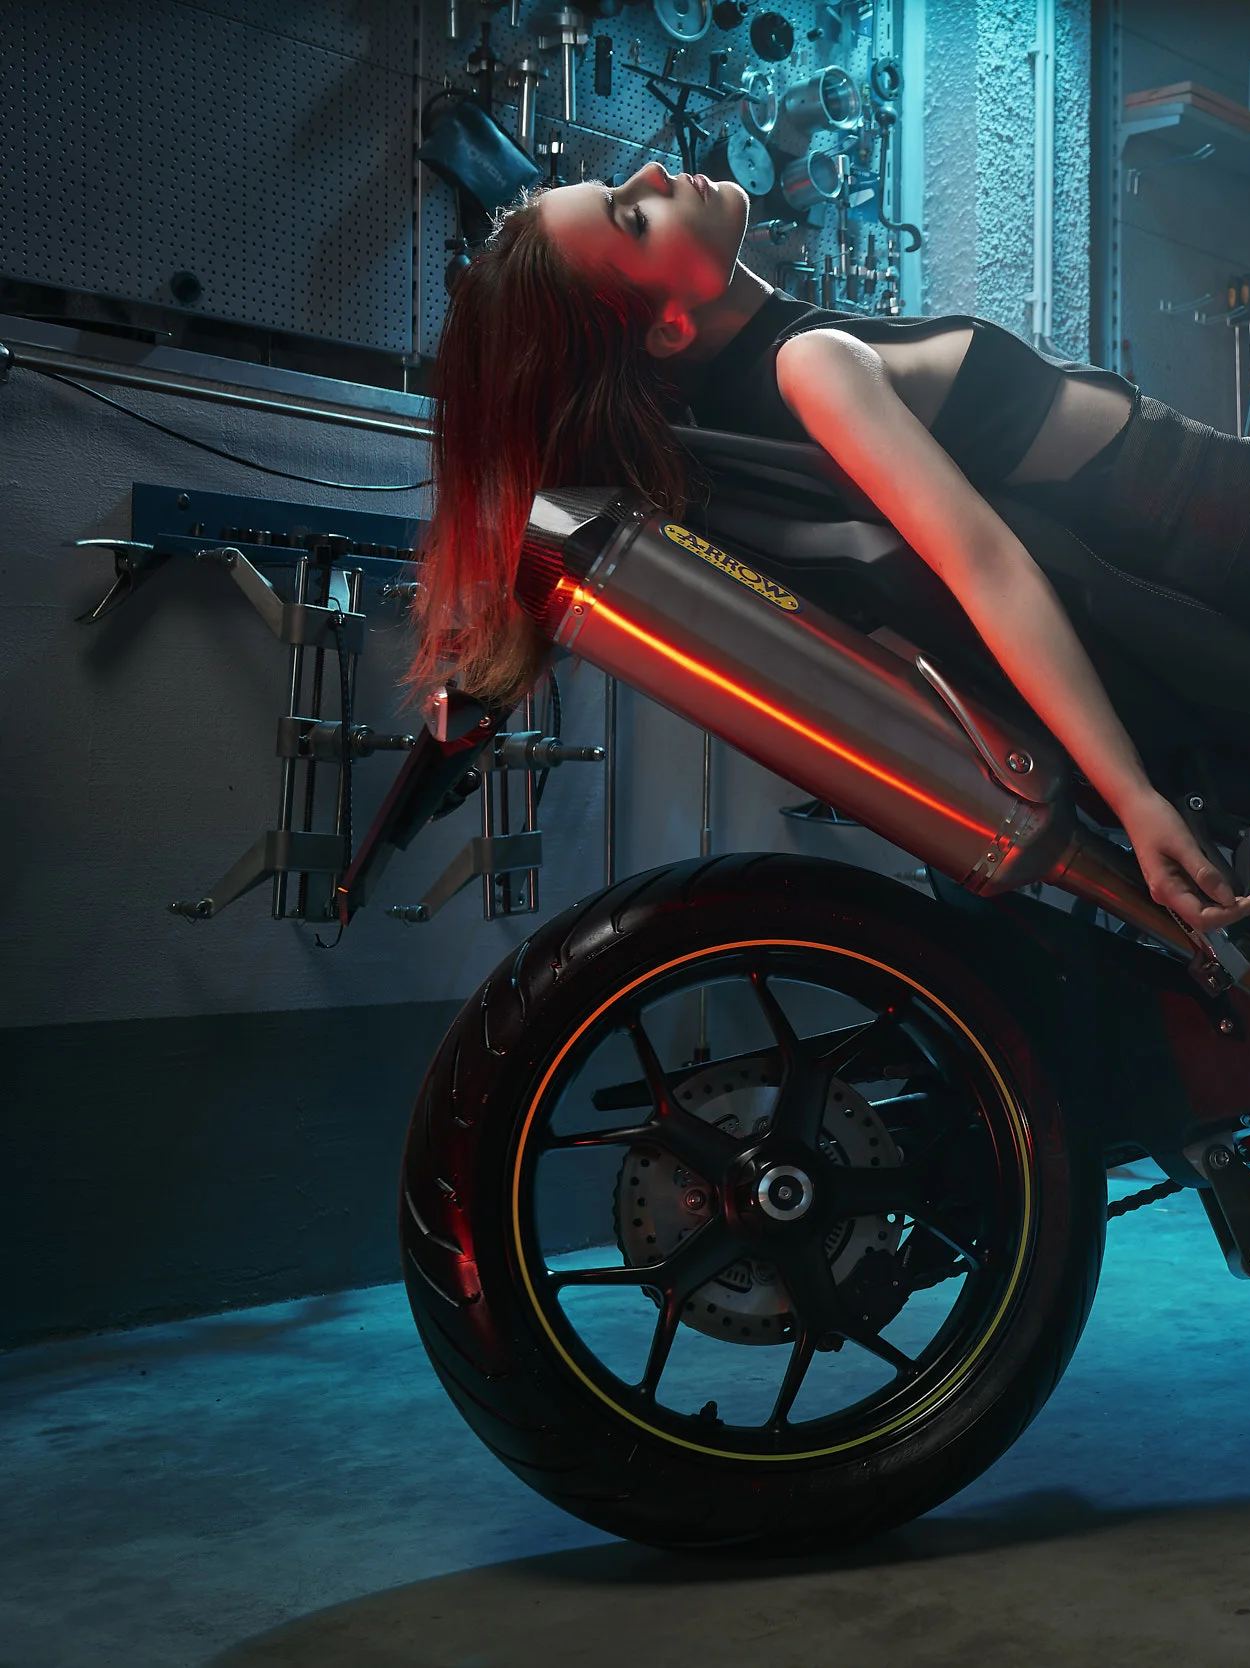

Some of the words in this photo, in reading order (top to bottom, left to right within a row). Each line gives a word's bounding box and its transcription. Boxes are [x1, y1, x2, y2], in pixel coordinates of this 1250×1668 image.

[677, 533, 791, 598] ARROW
[677, 539, 734, 576] SPECIAL
[738, 576, 784, 605] PARTS
